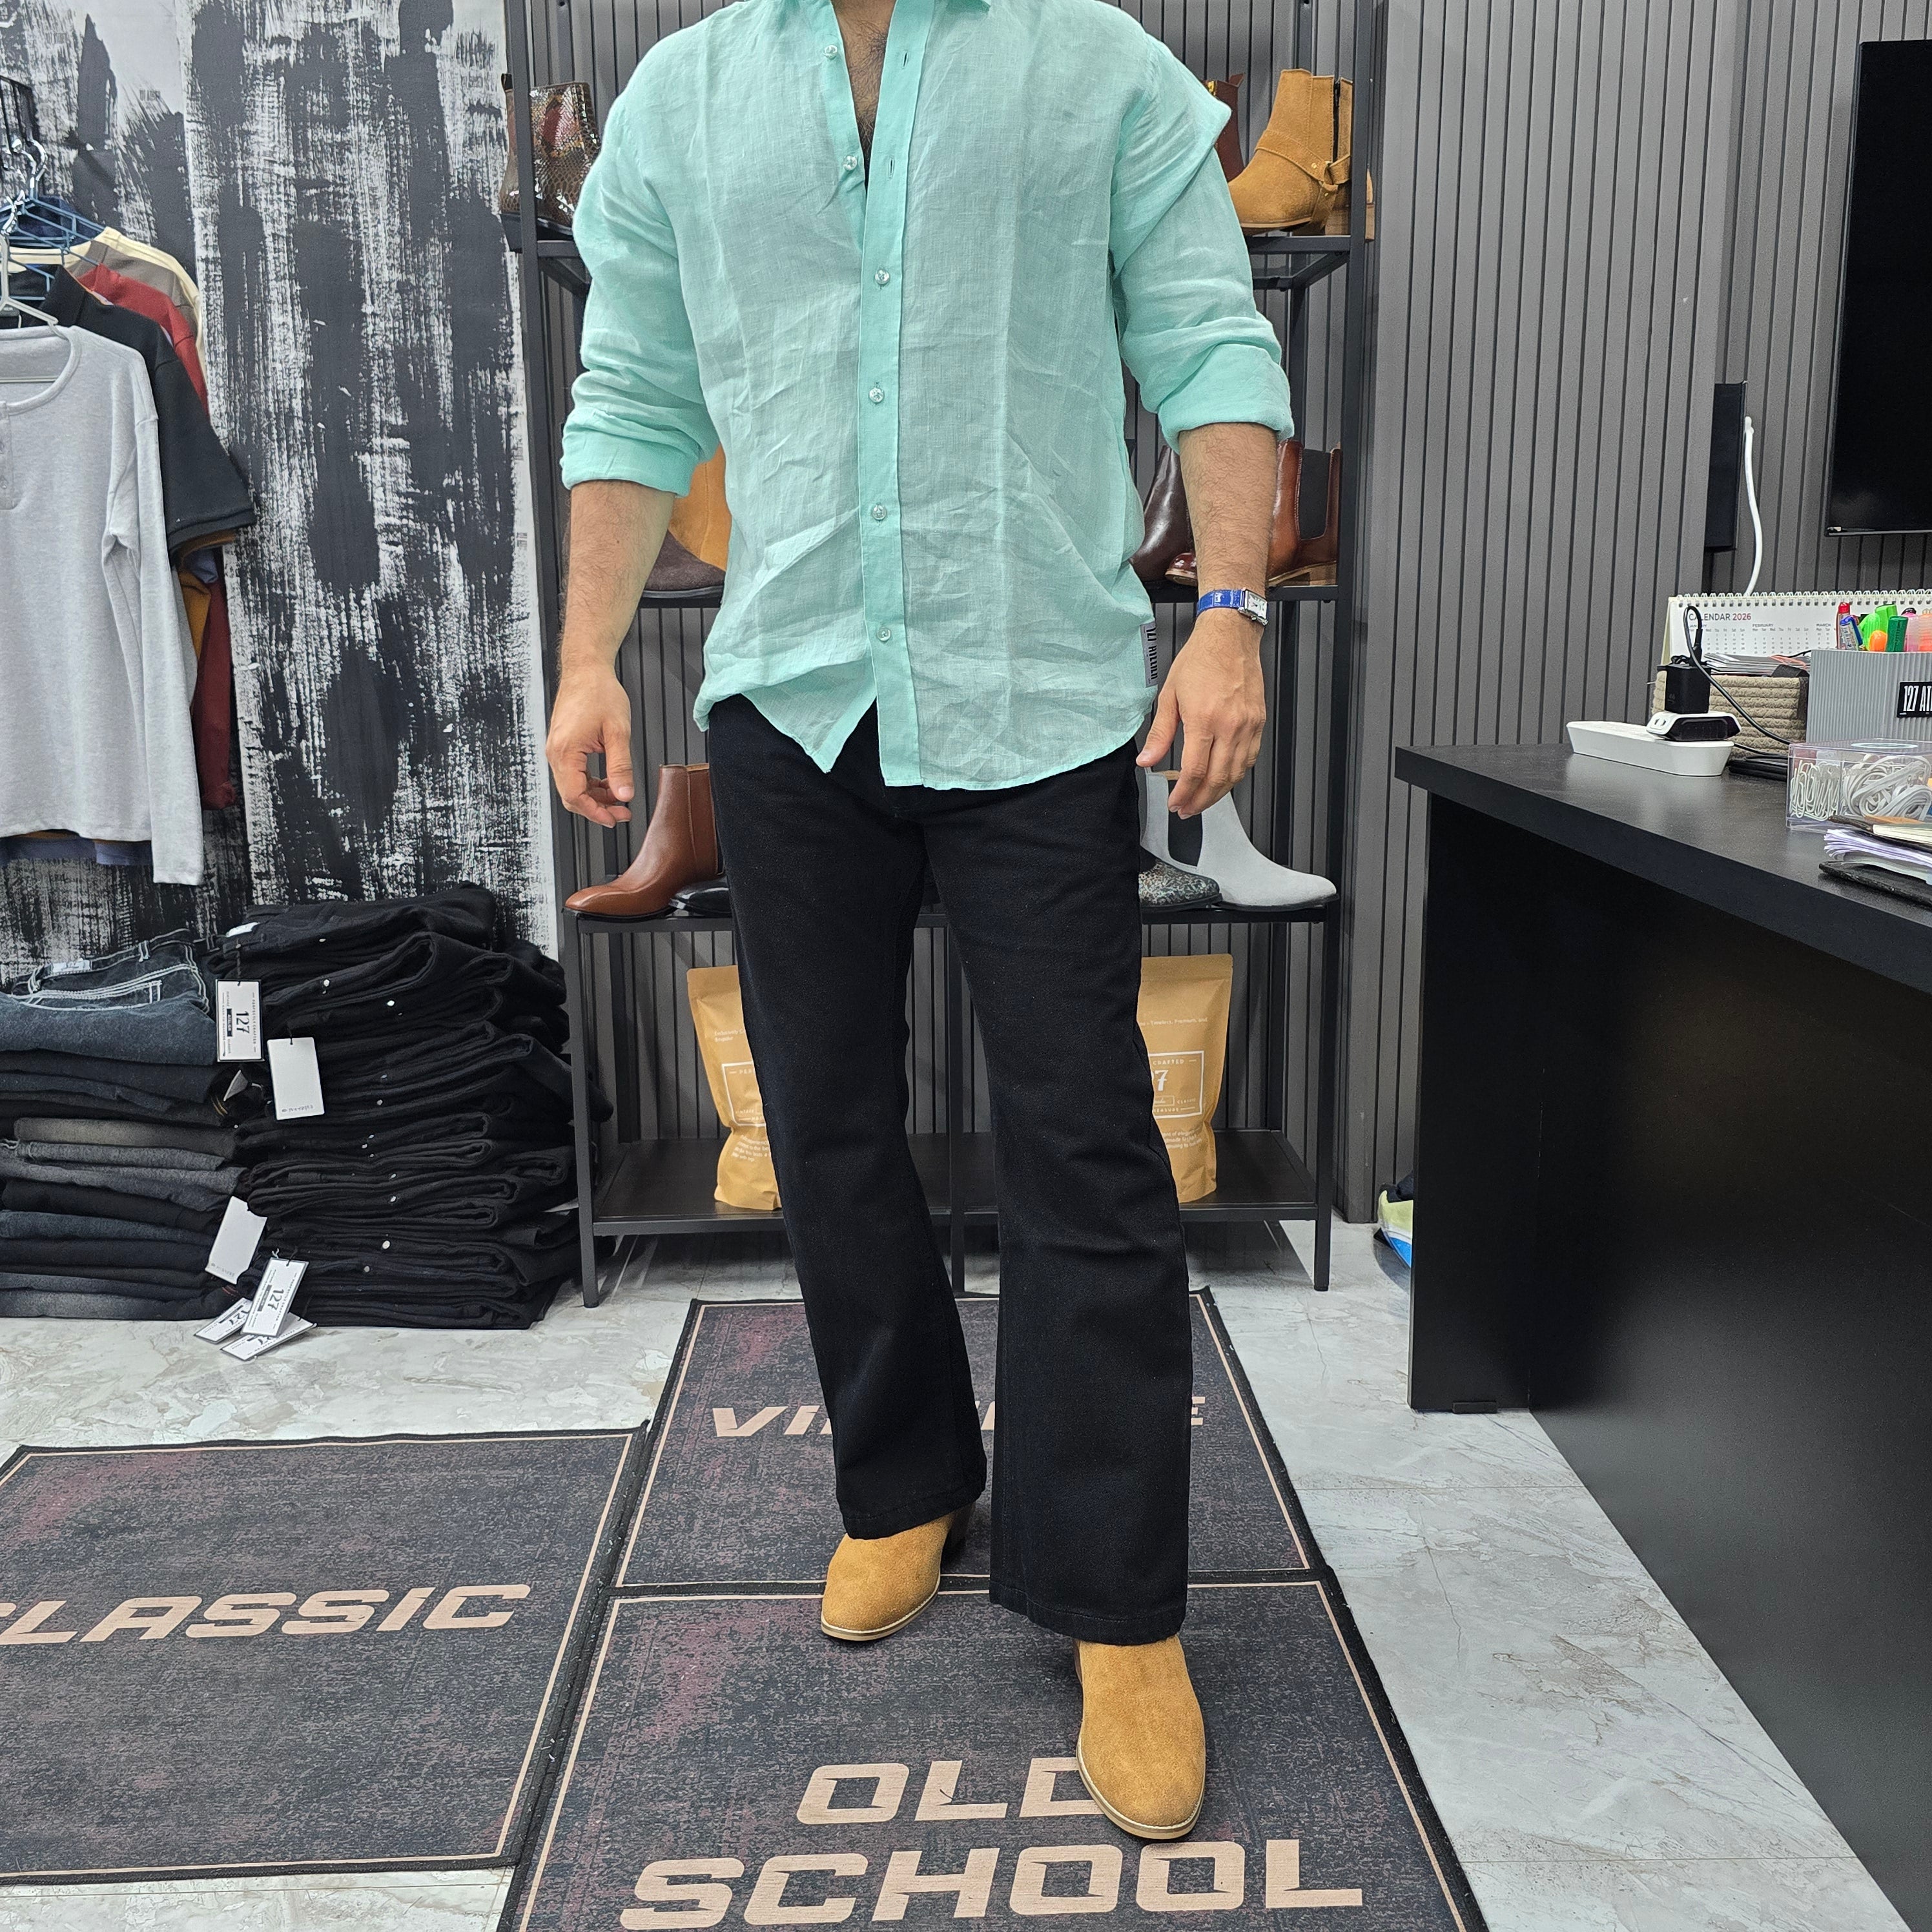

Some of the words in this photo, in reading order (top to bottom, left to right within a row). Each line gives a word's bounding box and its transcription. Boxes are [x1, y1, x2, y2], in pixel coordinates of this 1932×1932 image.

[1903, 685, 1919, 712] 127
[1919, 685, 1932, 712] AT
[236, 1011, 250, 1034] 127
[1151, 1070, 1169, 1091] 7
[267, 1289, 284, 1311] 127
[0, 1584, 531, 1645] LASSIC
[620, 1838, 1362, 1930] SCHOOL
